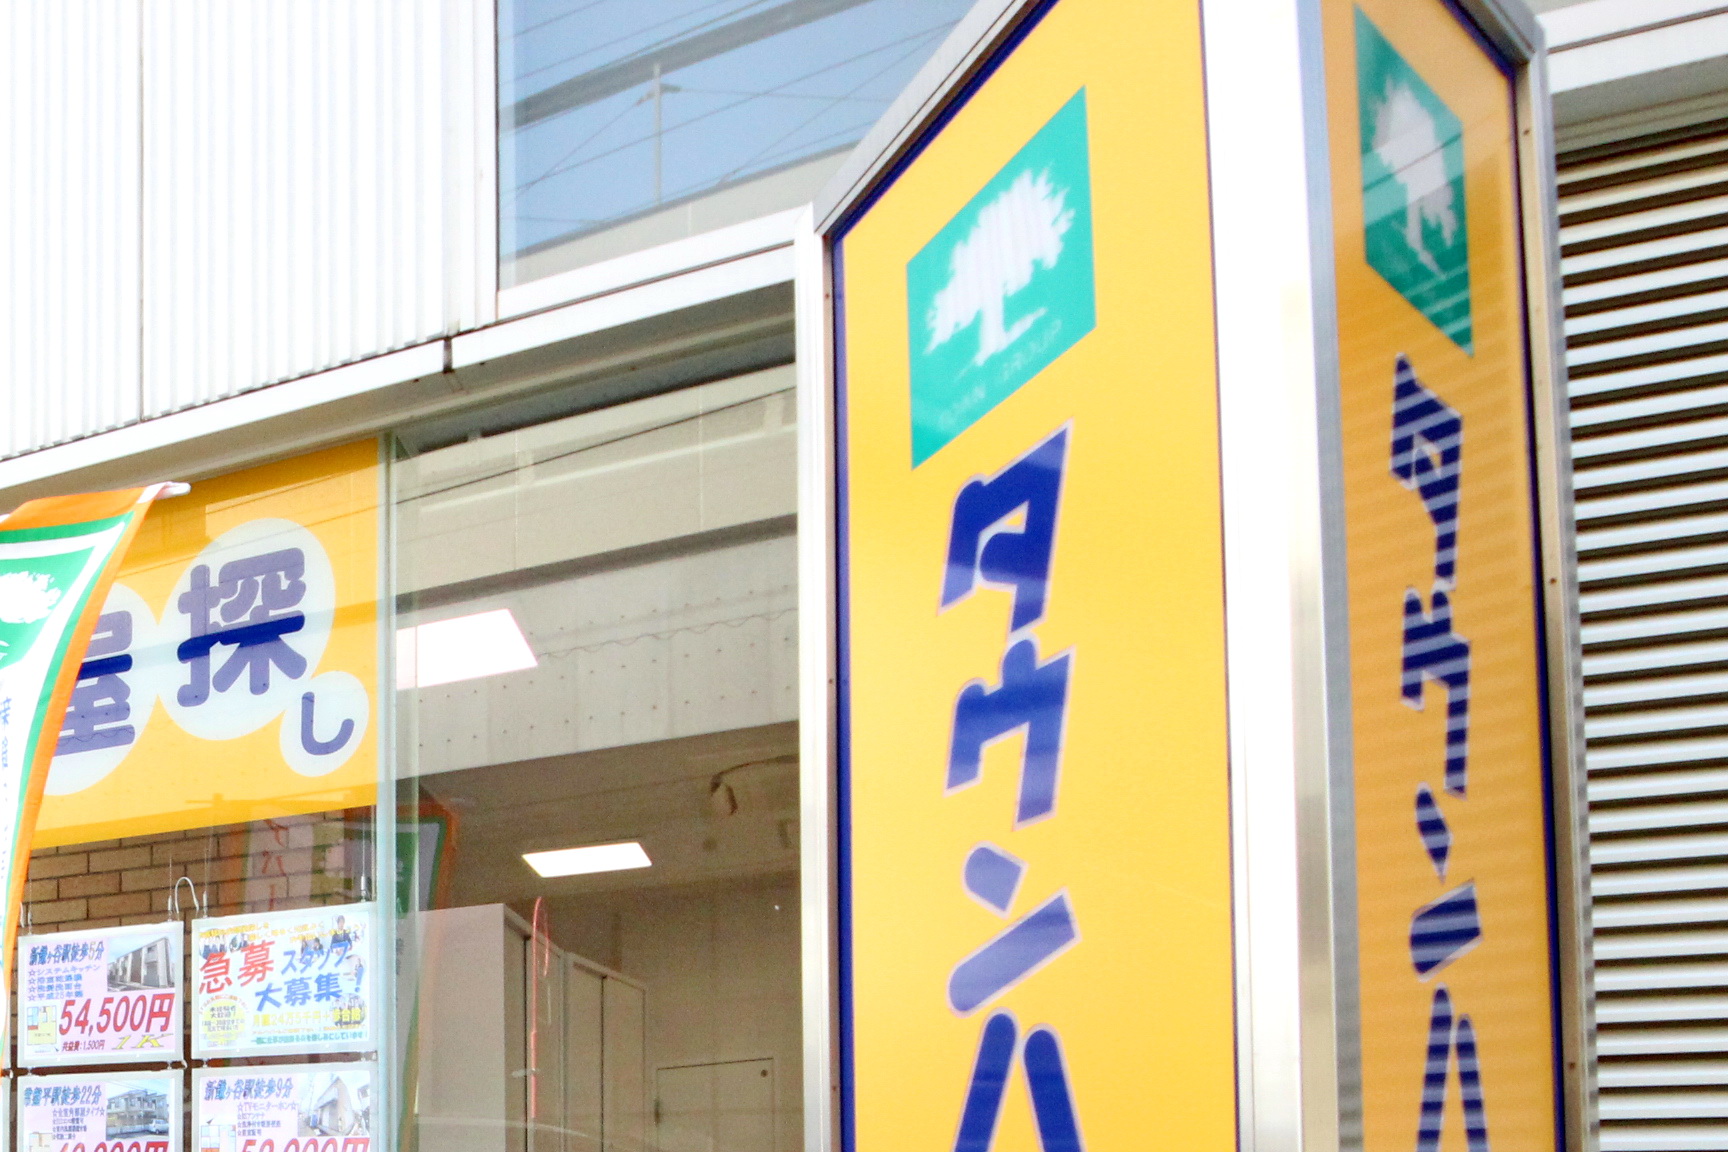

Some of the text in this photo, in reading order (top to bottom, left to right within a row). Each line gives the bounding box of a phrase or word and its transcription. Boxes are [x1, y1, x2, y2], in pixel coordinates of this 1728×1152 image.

[199, 939, 275, 995] 急募
[281, 941, 350, 975] スタッフ
[59, 993, 175, 1036] 54,500円
